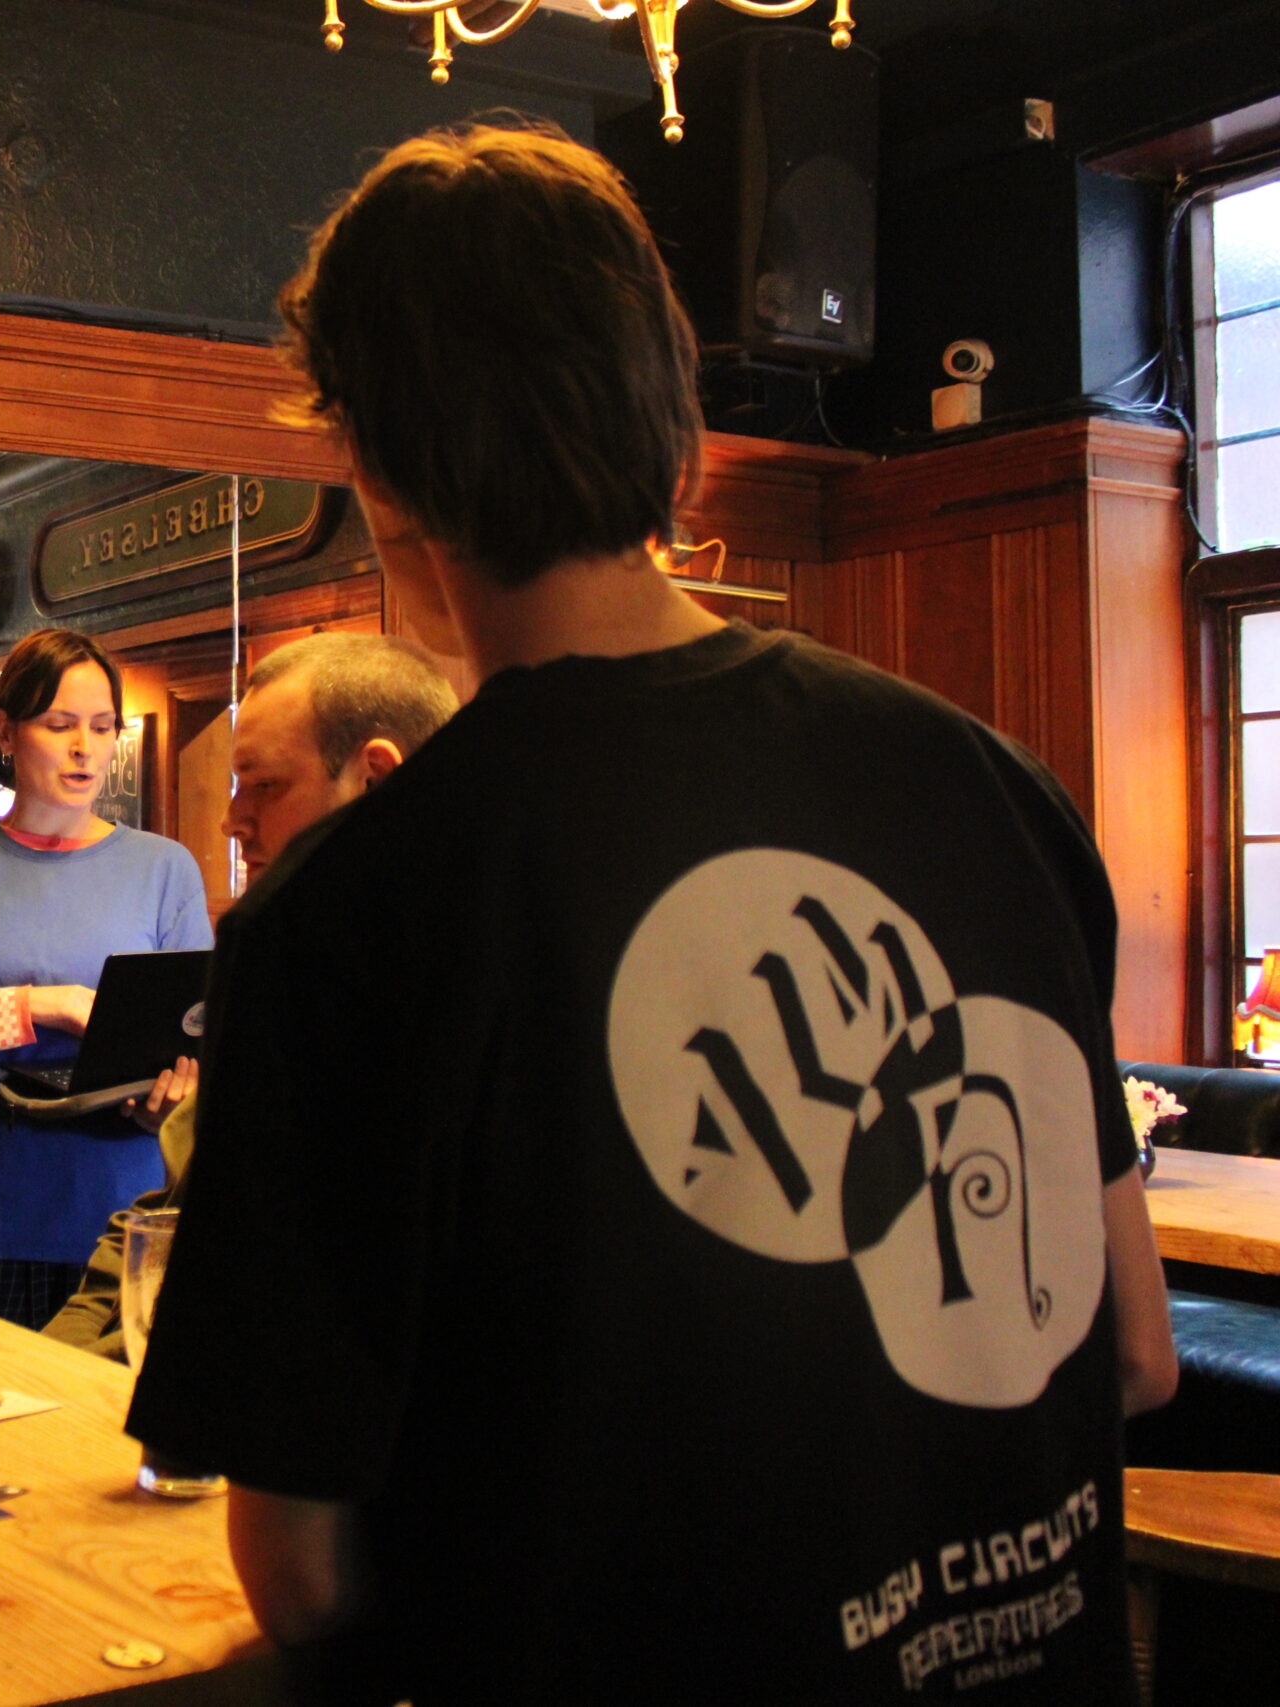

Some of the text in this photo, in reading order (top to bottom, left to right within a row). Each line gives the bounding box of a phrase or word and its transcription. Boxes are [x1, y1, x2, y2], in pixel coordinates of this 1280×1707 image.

[840, 1480, 1099, 1650] BUSY CIRCUITS
[953, 1650, 1045, 1689] LONDON
